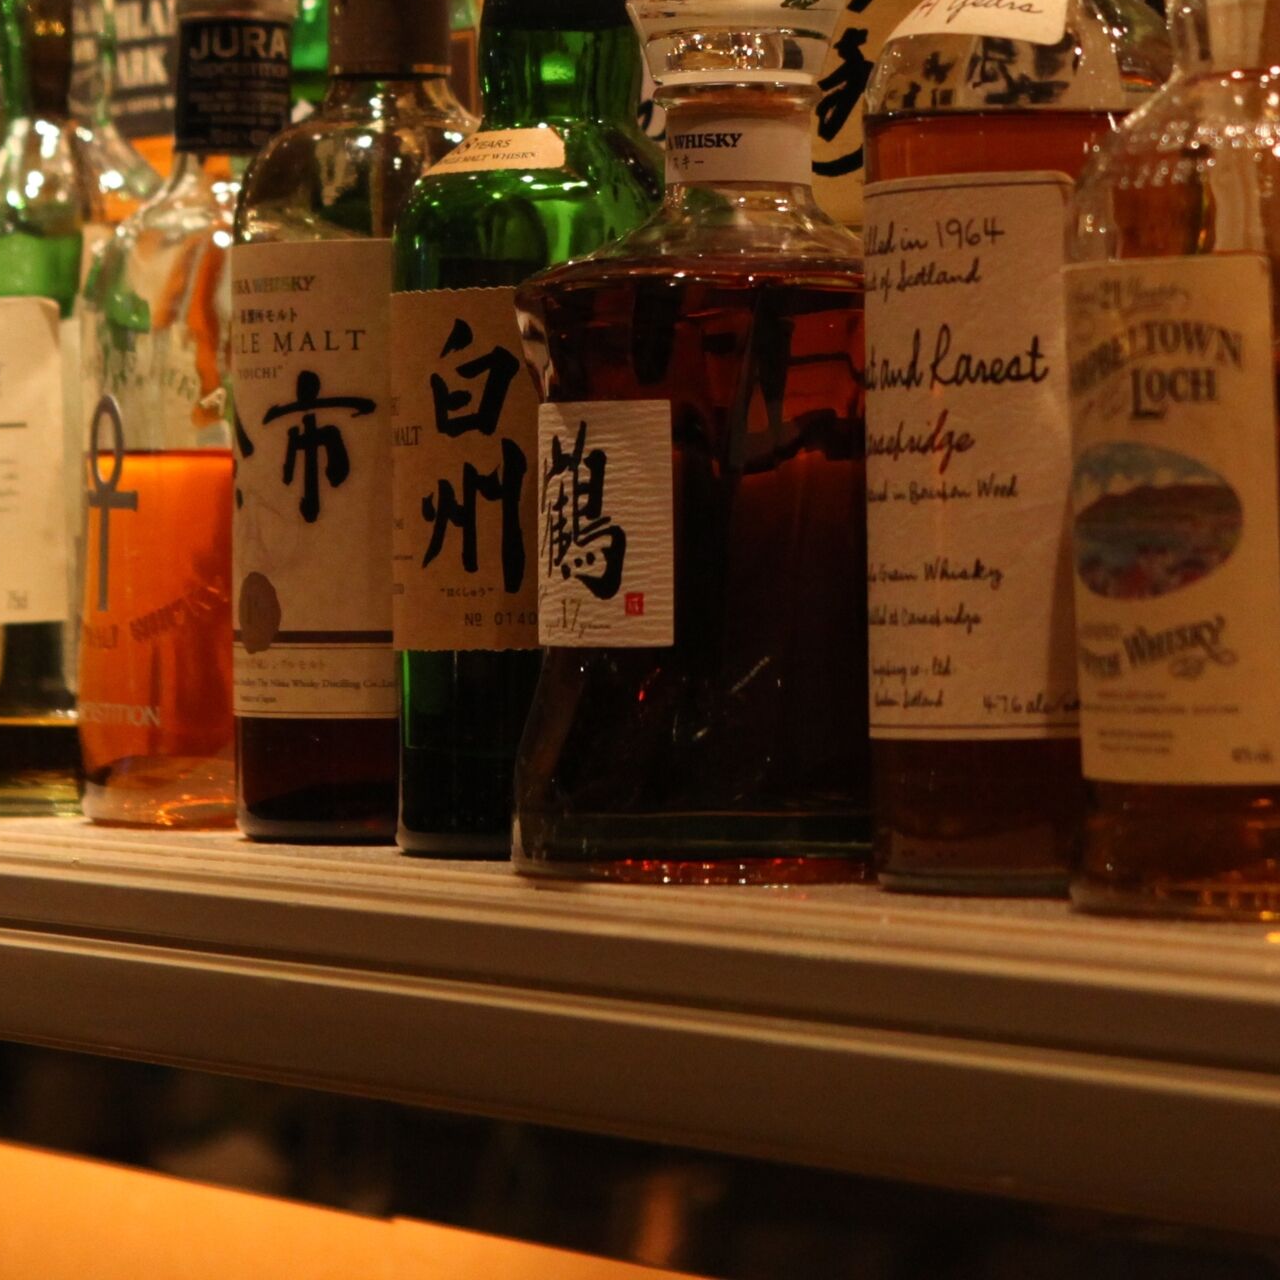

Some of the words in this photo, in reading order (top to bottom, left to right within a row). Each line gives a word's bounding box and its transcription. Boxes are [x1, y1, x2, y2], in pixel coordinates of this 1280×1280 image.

[189, 26, 289, 61] JURA
[673, 132, 743, 150] WHISKY
[900, 227, 928, 252] in
[935, 216, 1006, 251] 1964
[895, 257, 983, 293] Scotland
[272, 329, 367, 354] MALT
[881, 328, 924, 392] and
[930, 322, 1050, 392] Rarest
[1130, 367, 1218, 420] LOCH
[422, 317, 527, 595] 白州
[976, 472, 1019, 499] Wood
[541, 420, 627, 600] 鶴
